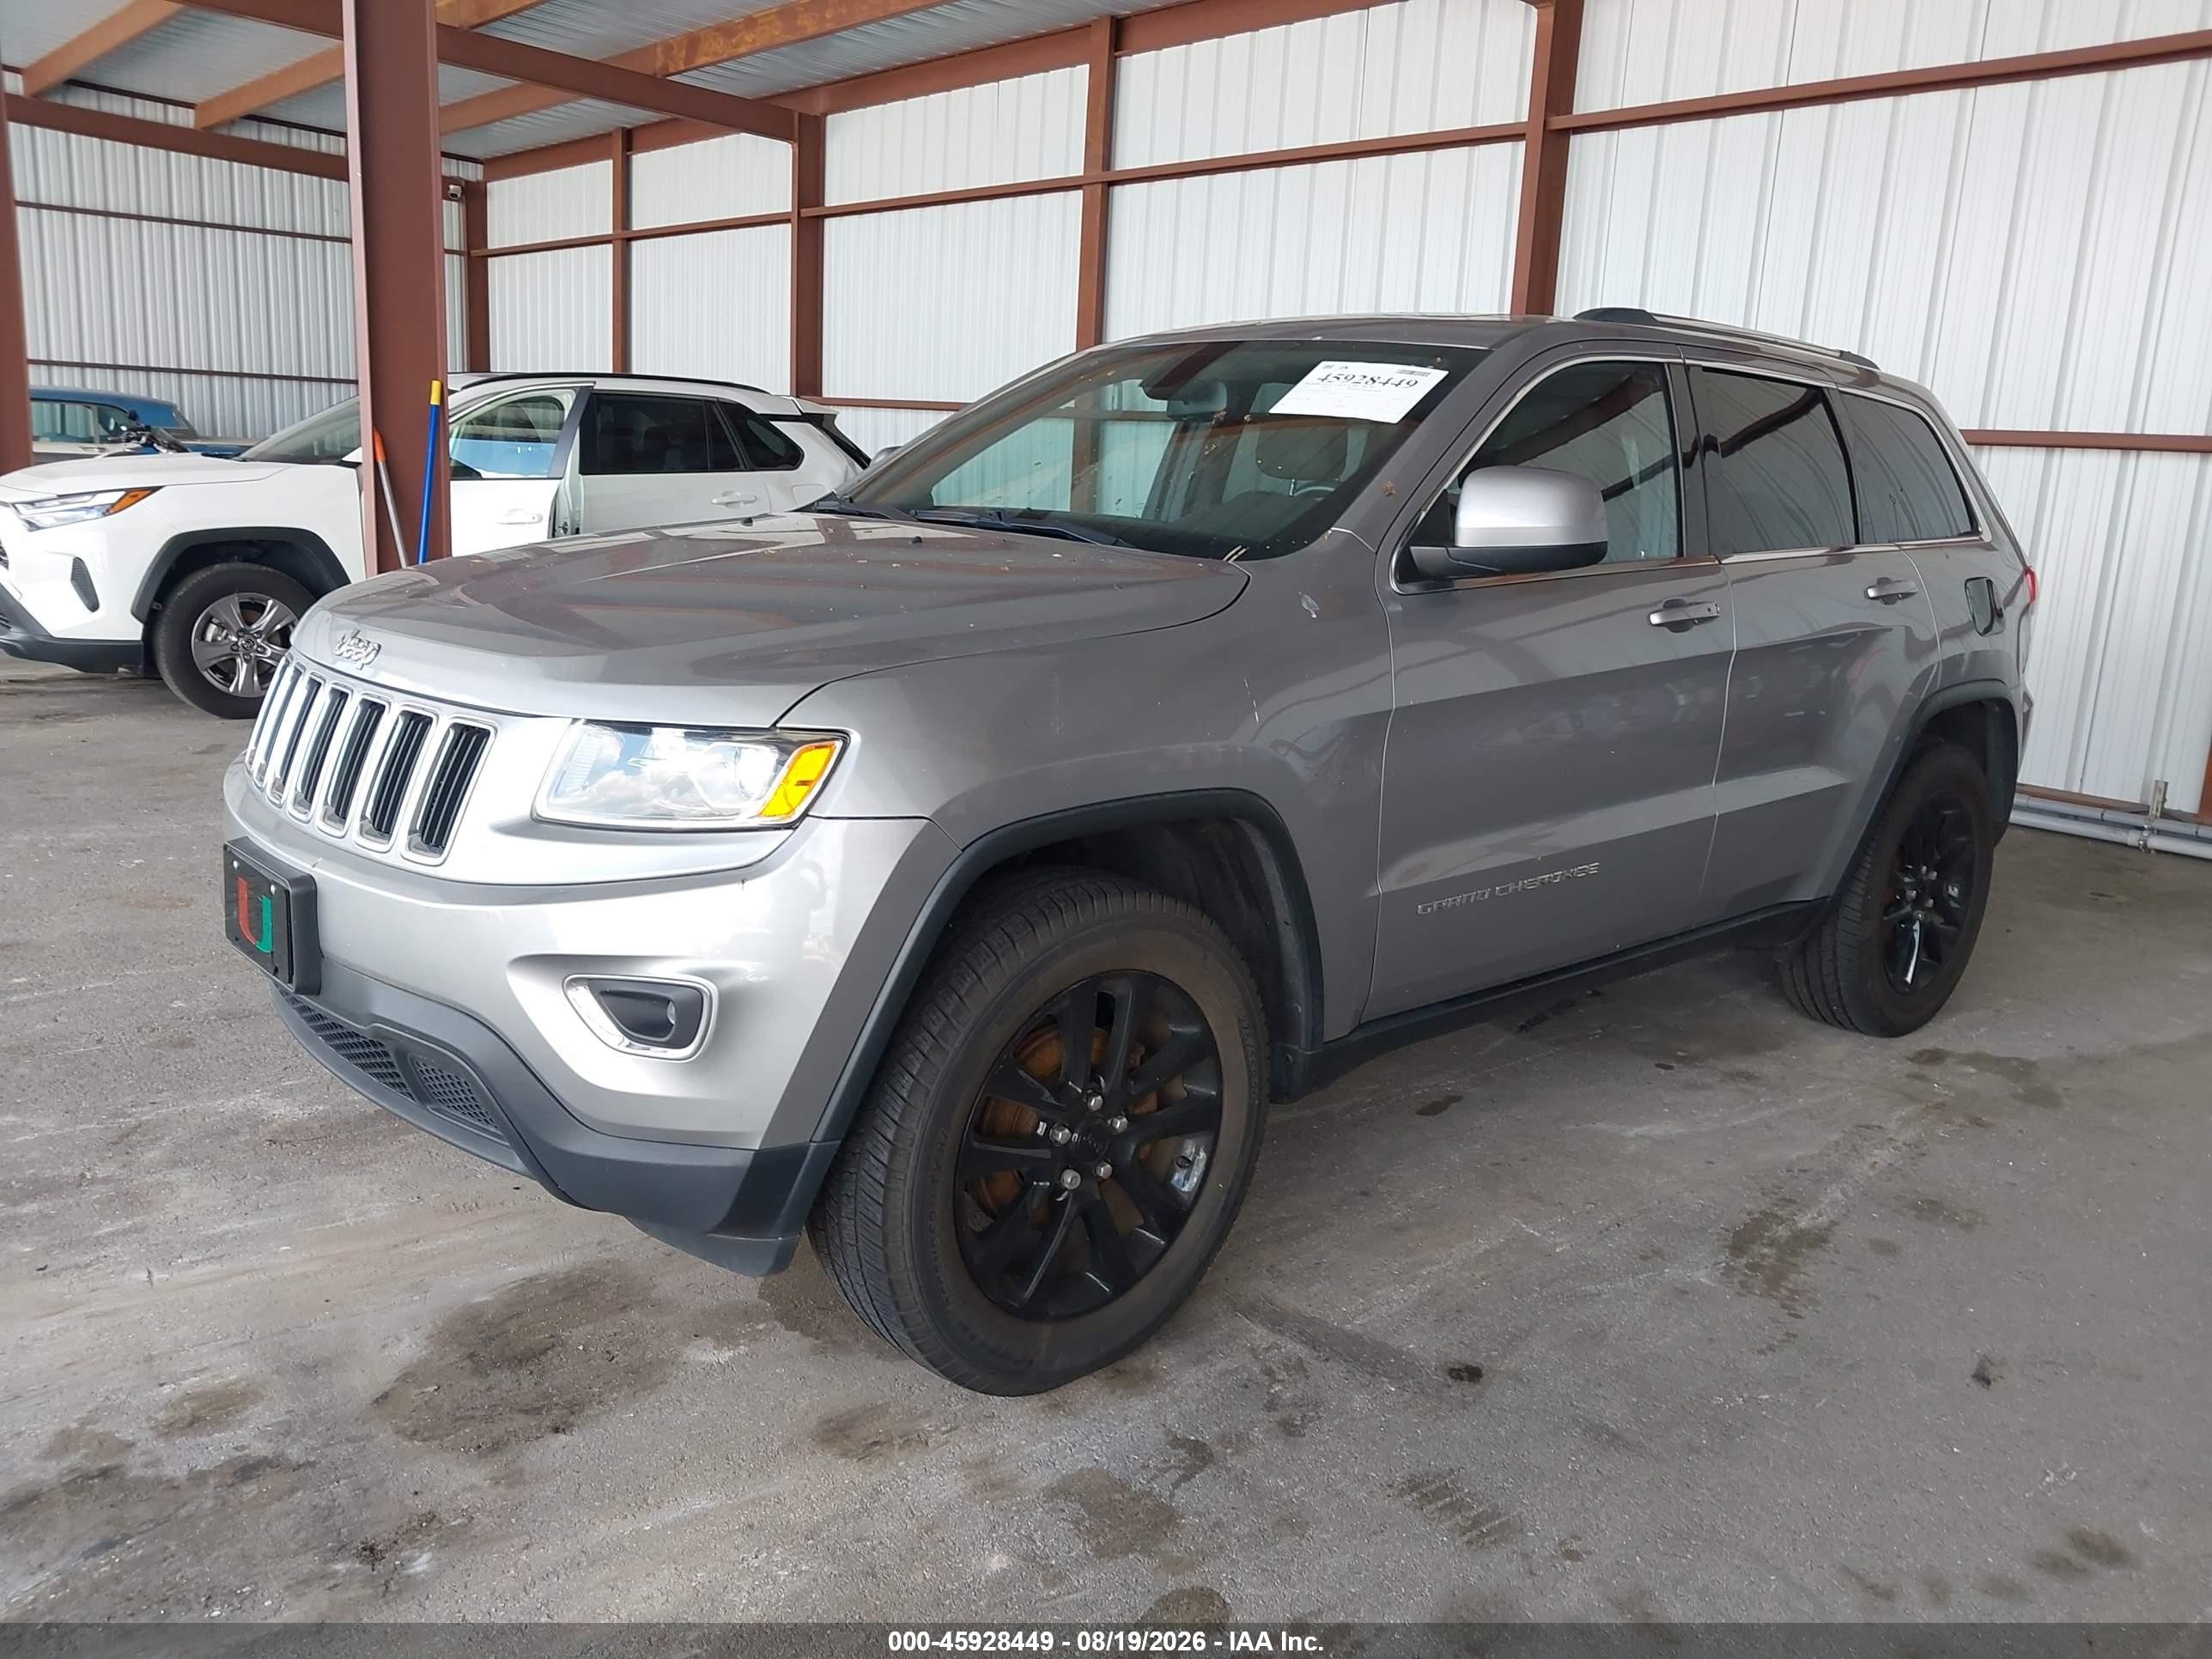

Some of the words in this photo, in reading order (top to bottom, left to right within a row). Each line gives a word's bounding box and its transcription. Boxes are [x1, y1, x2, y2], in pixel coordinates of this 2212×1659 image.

[1316, 372, 1419, 389] 45928449
[333, 629, 382, 671] Jeep
[1417, 887, 1492, 915] GRAND
[1495, 862, 1600, 897] CHEROKEE
